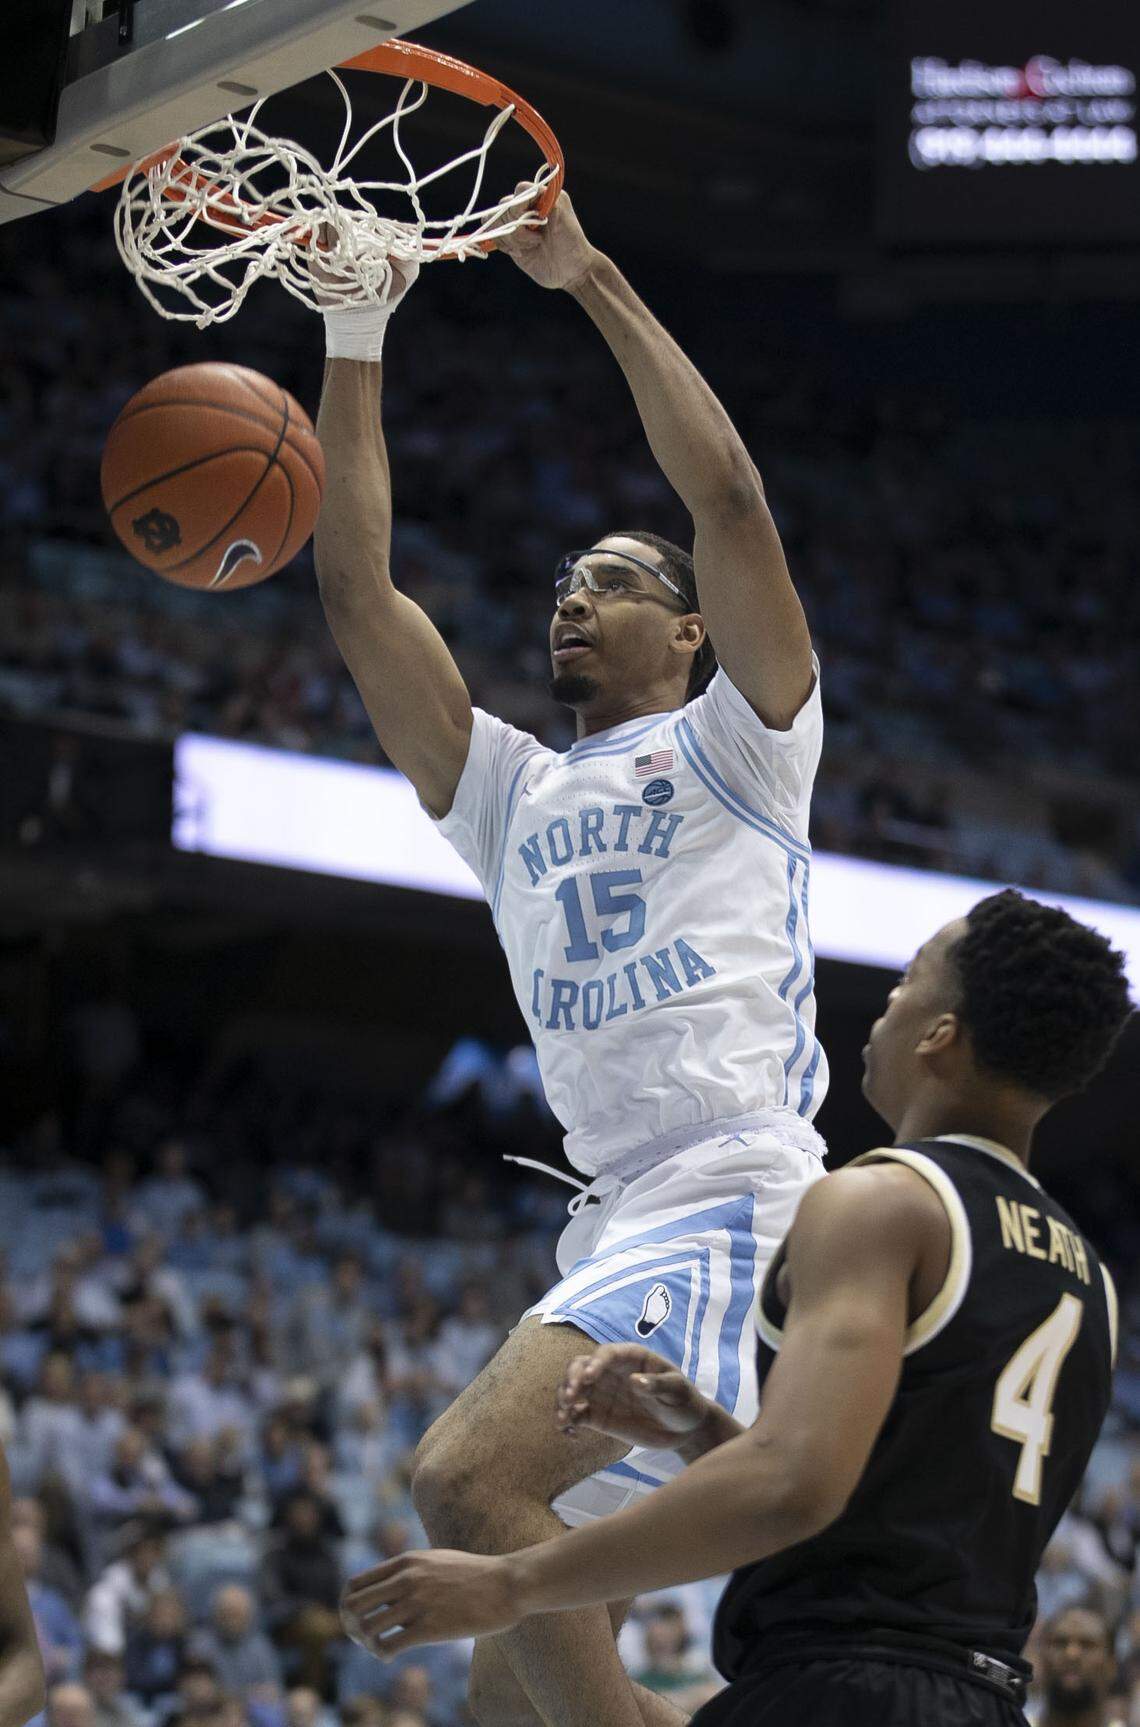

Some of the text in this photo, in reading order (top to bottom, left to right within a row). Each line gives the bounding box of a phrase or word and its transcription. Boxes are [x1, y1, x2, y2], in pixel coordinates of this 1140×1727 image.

[518, 804, 684, 887] NORTH
[555, 869, 647, 963] 15
[532, 938, 717, 1031] CROLINA
[995, 1195, 1090, 1285] NEATH
[991, 1292, 1084, 1507] 4
